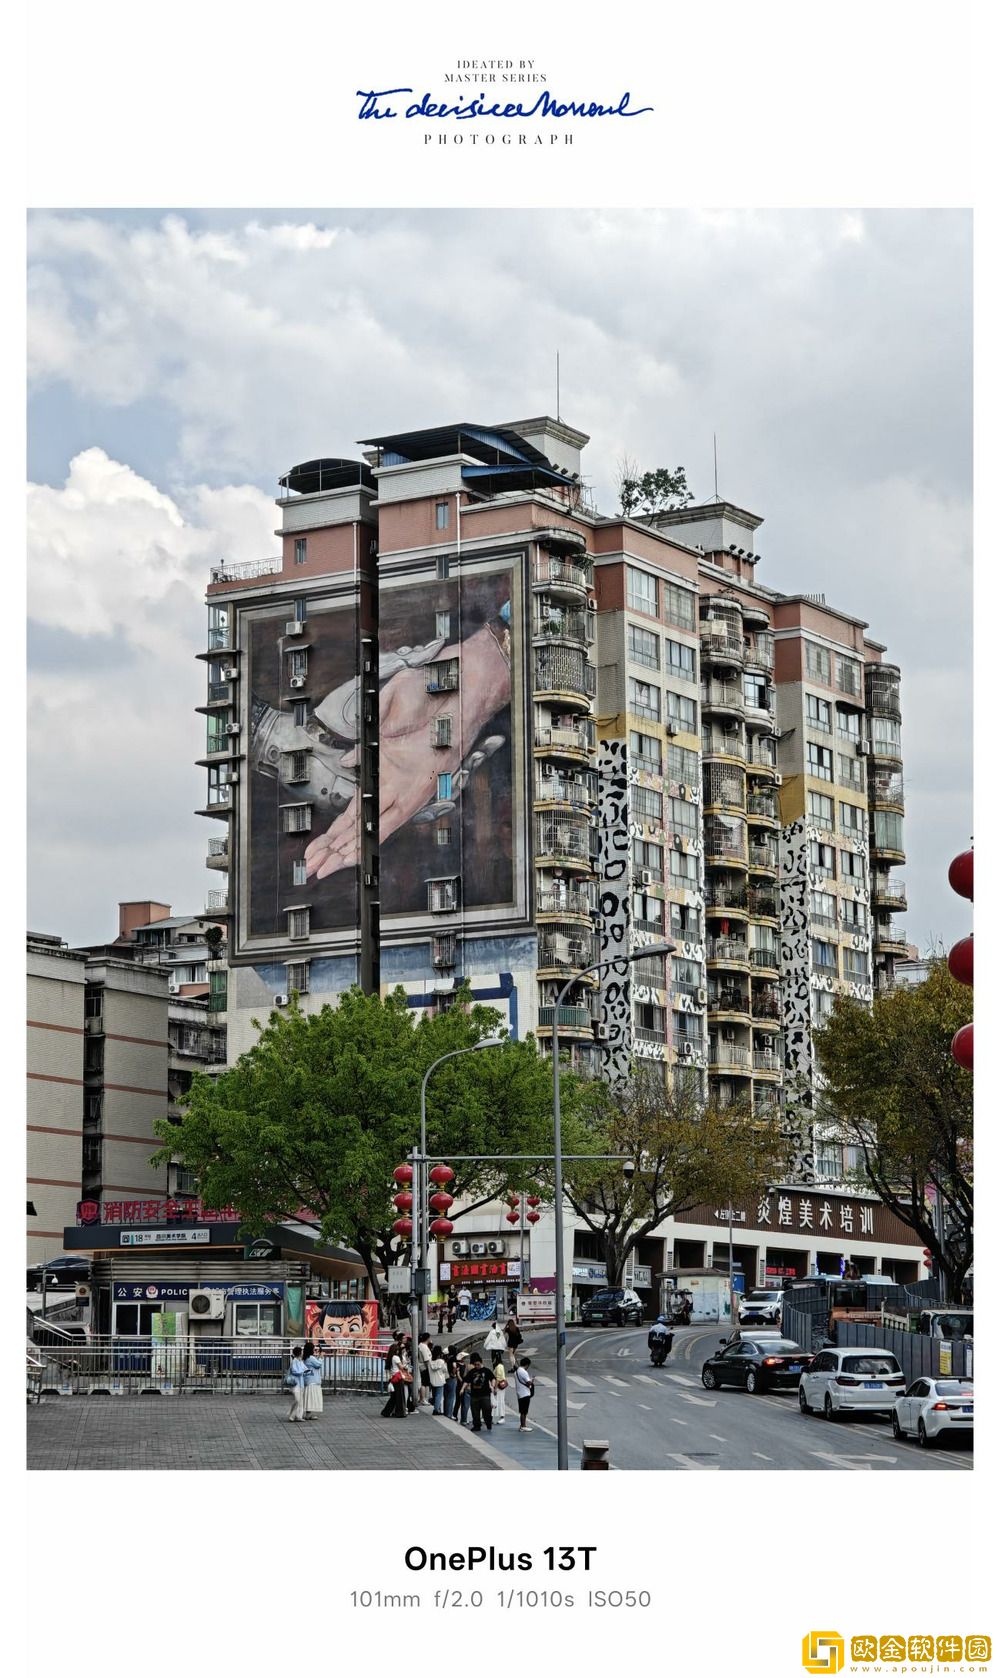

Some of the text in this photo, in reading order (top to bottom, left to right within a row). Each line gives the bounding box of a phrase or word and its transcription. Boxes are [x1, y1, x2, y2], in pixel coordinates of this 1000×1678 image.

[757, 1195, 874, 1235] 炎煌美术培训
[135, 1234, 144, 1243] 18
[117, 1287, 189, 1297] 公安 POLIC
